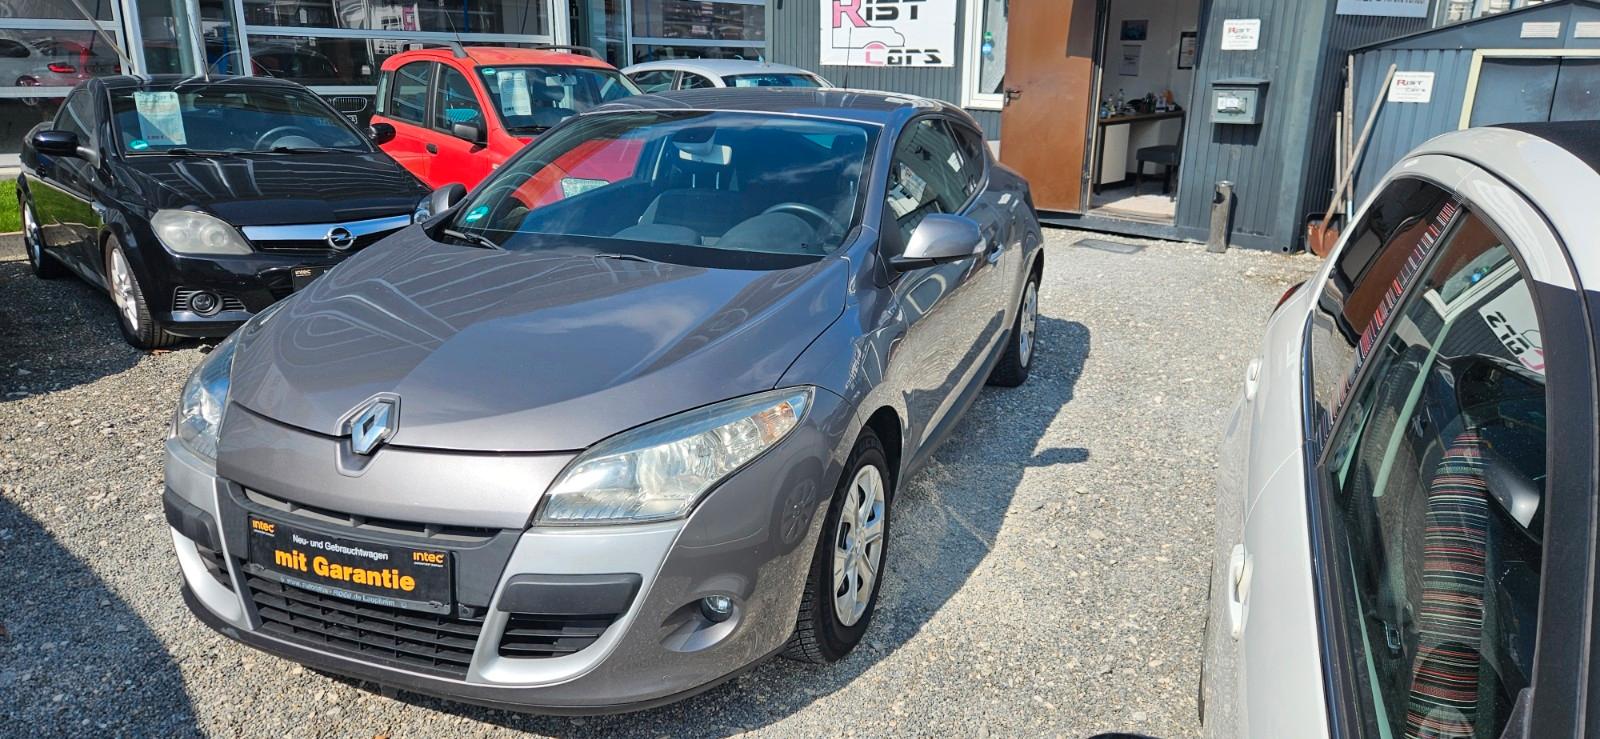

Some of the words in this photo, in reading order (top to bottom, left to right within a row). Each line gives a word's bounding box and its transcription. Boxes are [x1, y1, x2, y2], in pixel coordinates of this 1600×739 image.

[865, 43, 942, 65] Cars
[292, 534, 309, 546] Neu-
[310, 539, 324, 549] und
[325, 541, 389, 561] Gebrauchtwagen
[275, 549, 308, 572] mit
[313, 555, 416, 592] Garantie
